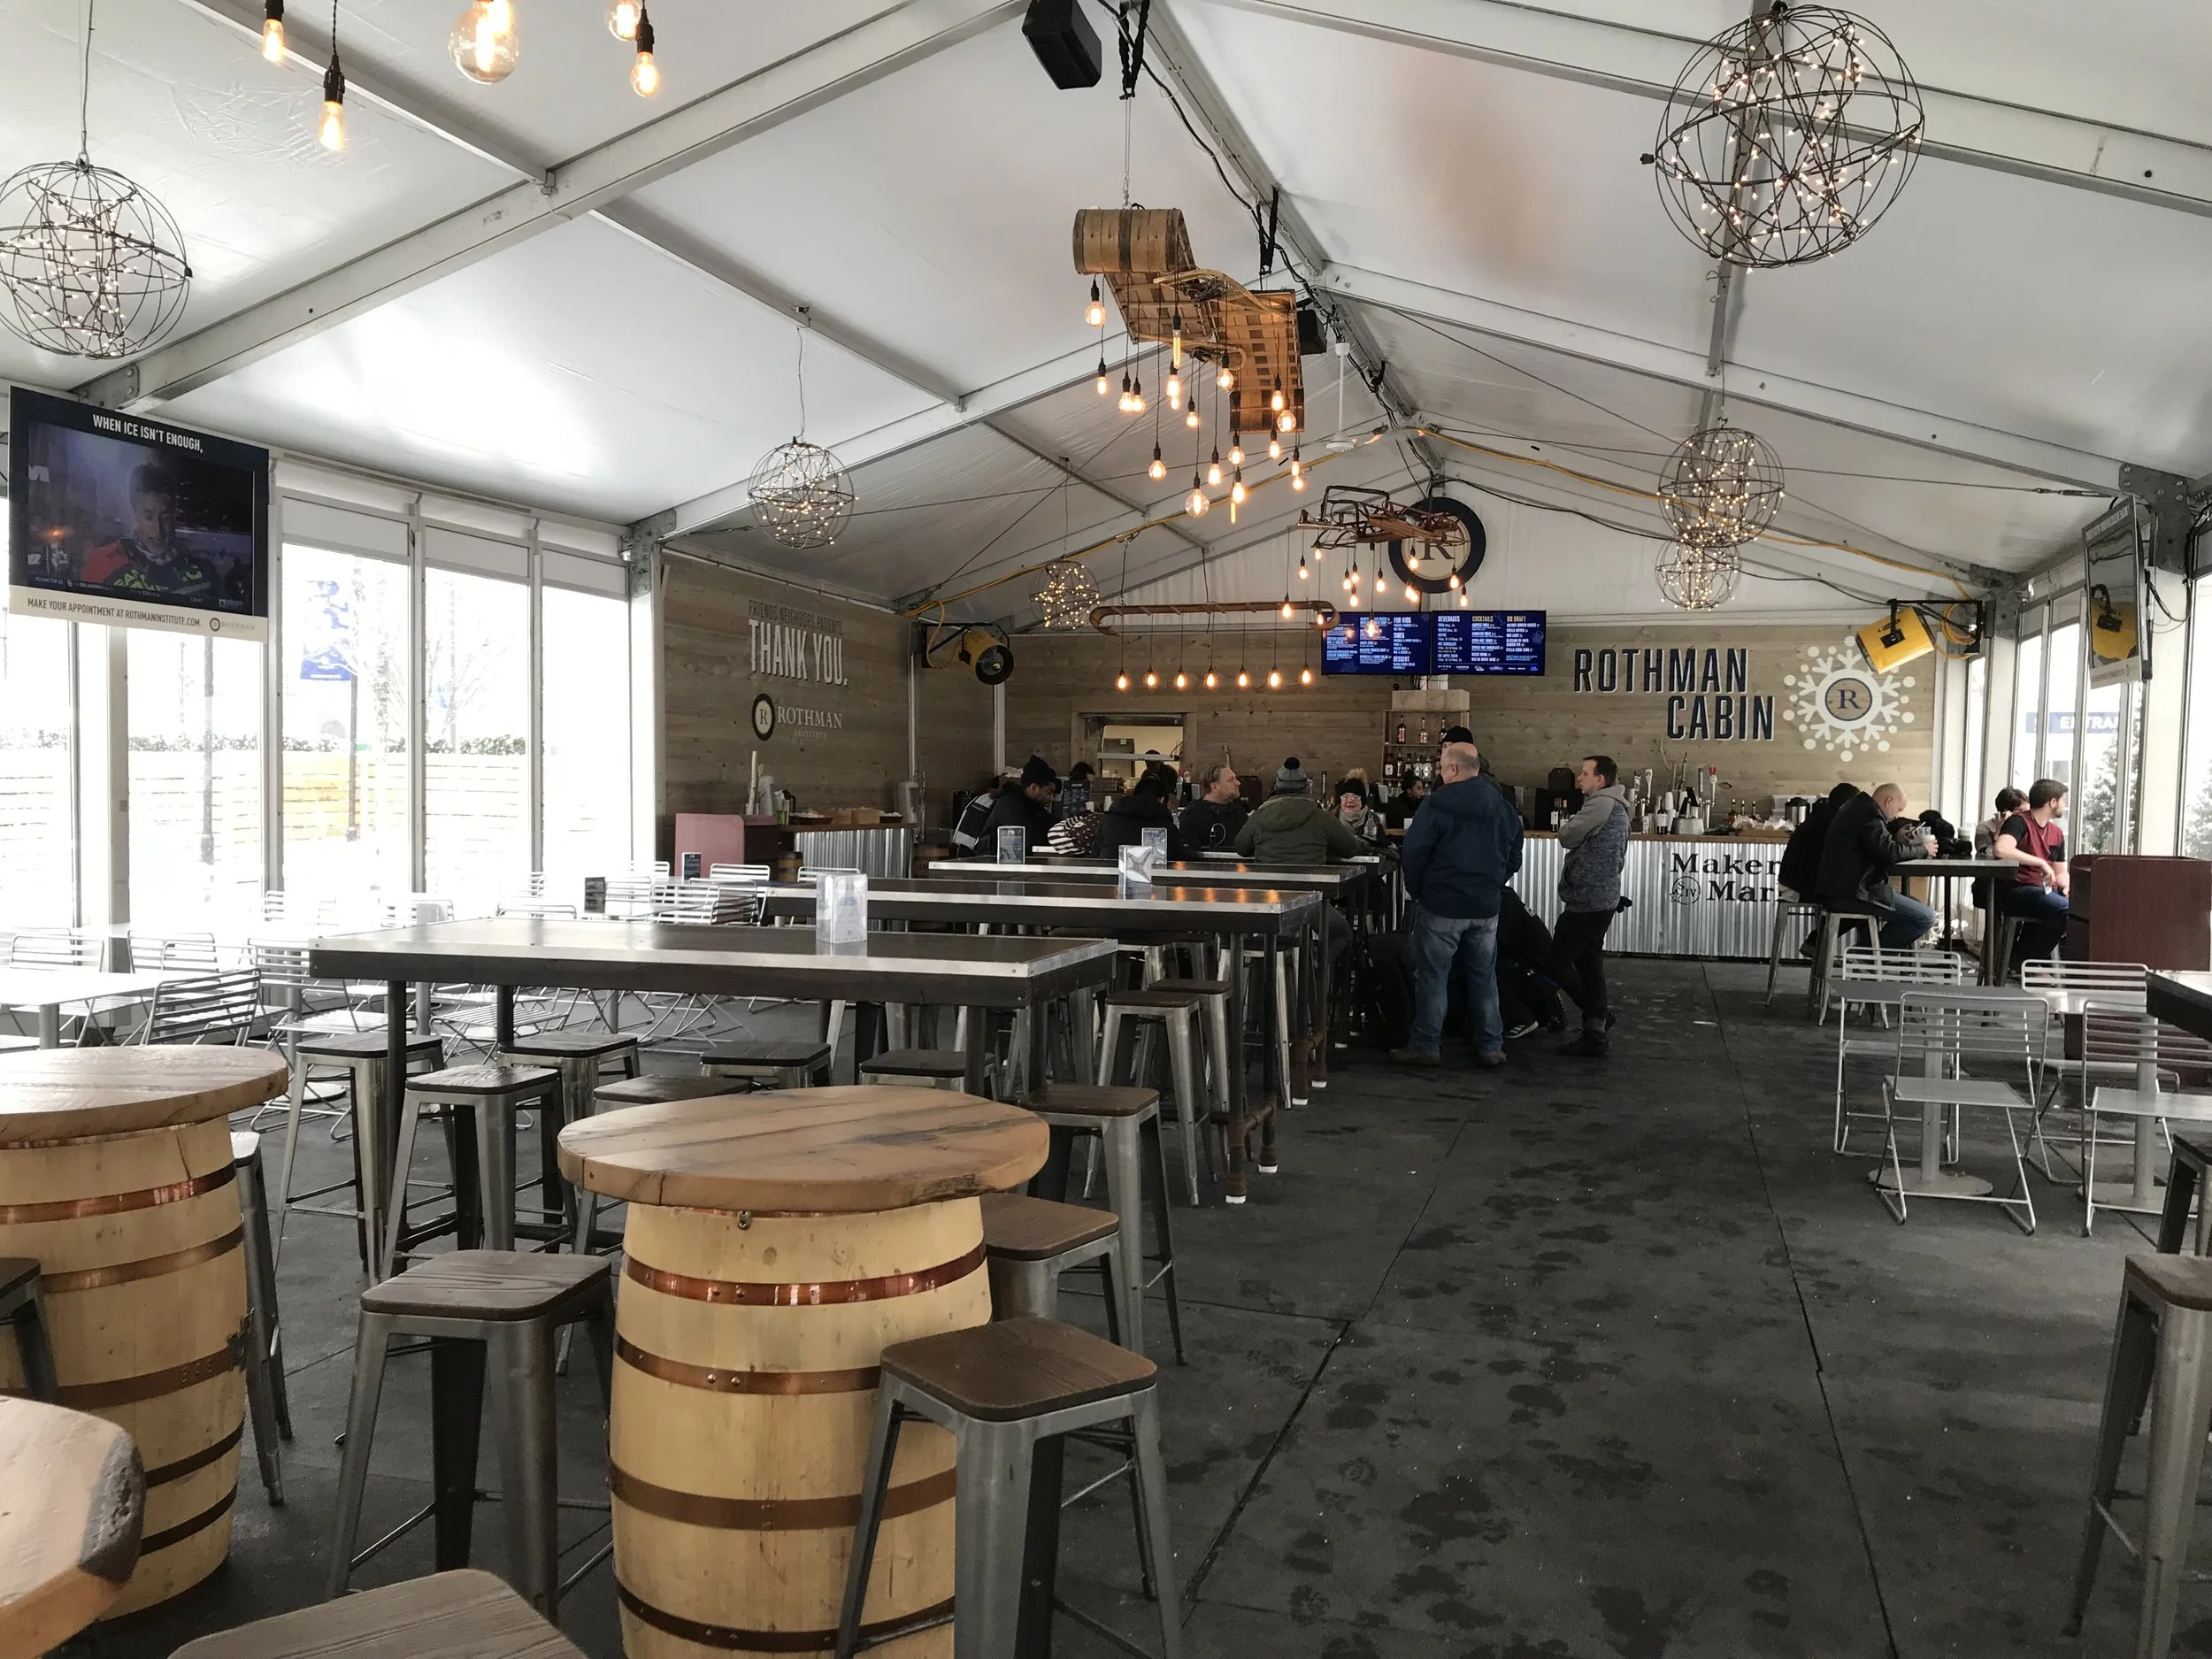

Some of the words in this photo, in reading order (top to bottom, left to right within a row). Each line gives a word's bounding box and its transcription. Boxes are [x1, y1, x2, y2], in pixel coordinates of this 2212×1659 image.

[92, 414, 121, 433] WHEN
[124, 421, 138, 437] ICE
[141, 426, 165, 442] ISN'T
[166, 432, 204, 454] ENOUGH,
[27, 597, 48, 610] MAKE
[49, 601, 67, 611] YOUR
[68, 603, 115, 618] APPOINTMENT
[116, 609, 124, 618] AT
[221, 620, 255, 631] ROTHMAN
[748, 618, 808, 680] THANK
[813, 633, 848, 686] YOU.
[1573, 648, 1749, 695] ROTHMAN
[1837, 688, 1863, 710] R
[759, 708, 769, 726] R
[777, 706, 842, 729] ROTHMAN
[1666, 695, 1776, 741] CABIN
[1670, 852, 1782, 876] Maker
[1706, 880, 1784, 902] Mar
